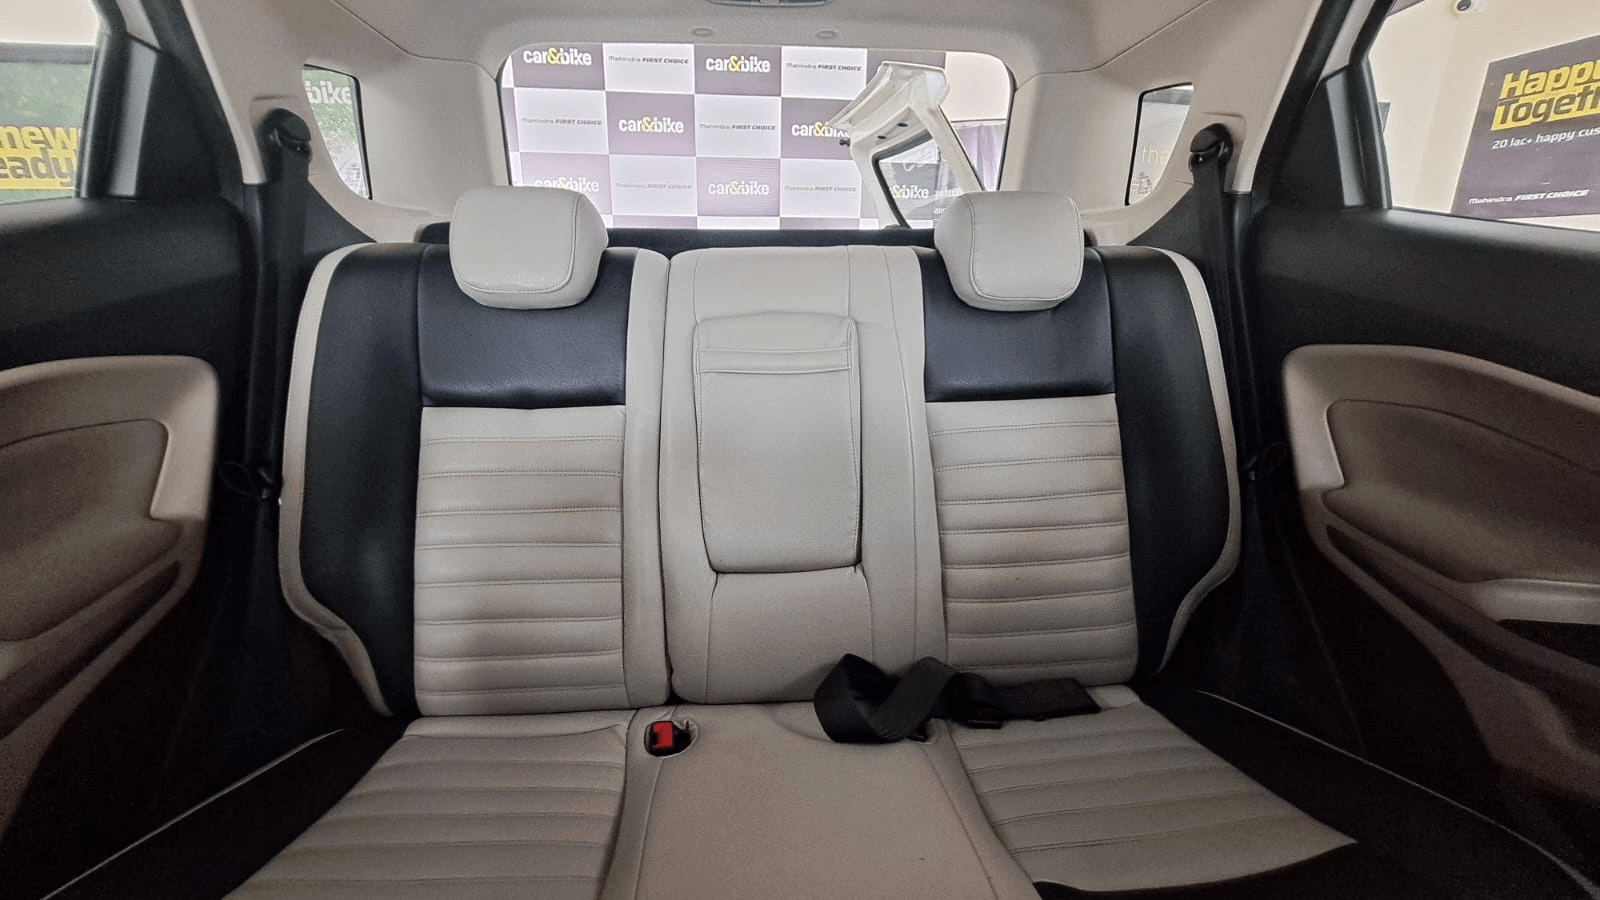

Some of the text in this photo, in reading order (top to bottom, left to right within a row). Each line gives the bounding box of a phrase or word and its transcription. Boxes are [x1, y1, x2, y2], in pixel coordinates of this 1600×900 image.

[523, 47, 592, 66] car&bike
[705, 55, 771, 73] car&bike
[618, 116, 684, 134] car&bike
[1491, 139, 1508, 150] 20
[1510, 137, 1533, 147] lac+
[1535, 130, 1576, 143] happy
[708, 180, 770, 196] car&bike
[1468, 189, 1590, 204] Mahindra FIRST CHOICE
